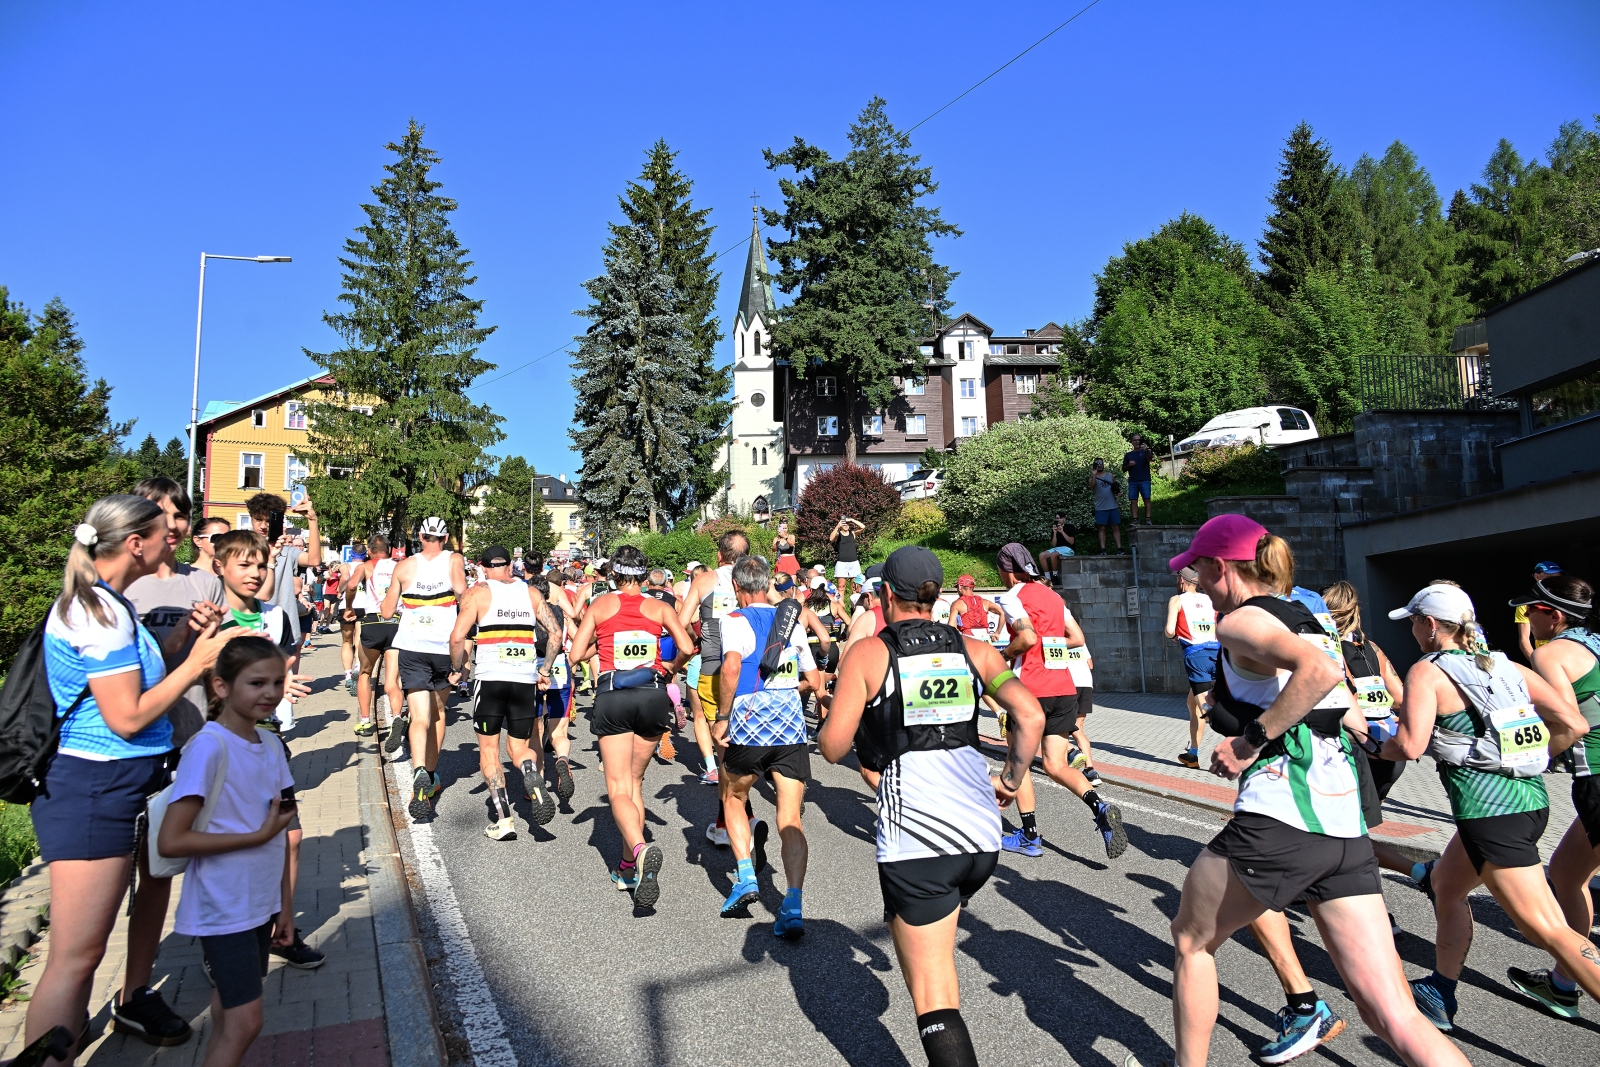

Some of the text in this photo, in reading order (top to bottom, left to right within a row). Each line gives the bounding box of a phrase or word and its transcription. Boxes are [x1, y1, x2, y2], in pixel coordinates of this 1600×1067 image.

[416, 581, 444, 592] Begium
[418, 615, 435, 624] 23
[497, 609, 530, 619] Belgium
[778, 605, 794, 636] ULTRA
[783, 607, 798, 640] SALOMON
[505, 647, 527, 657] 234
[623, 644, 648, 657] 605
[1049, 648, 1063, 658] 559
[1068, 651, 1081, 659] 210
[919, 678, 960, 700] 622
[1514, 724, 1543, 746] 658
